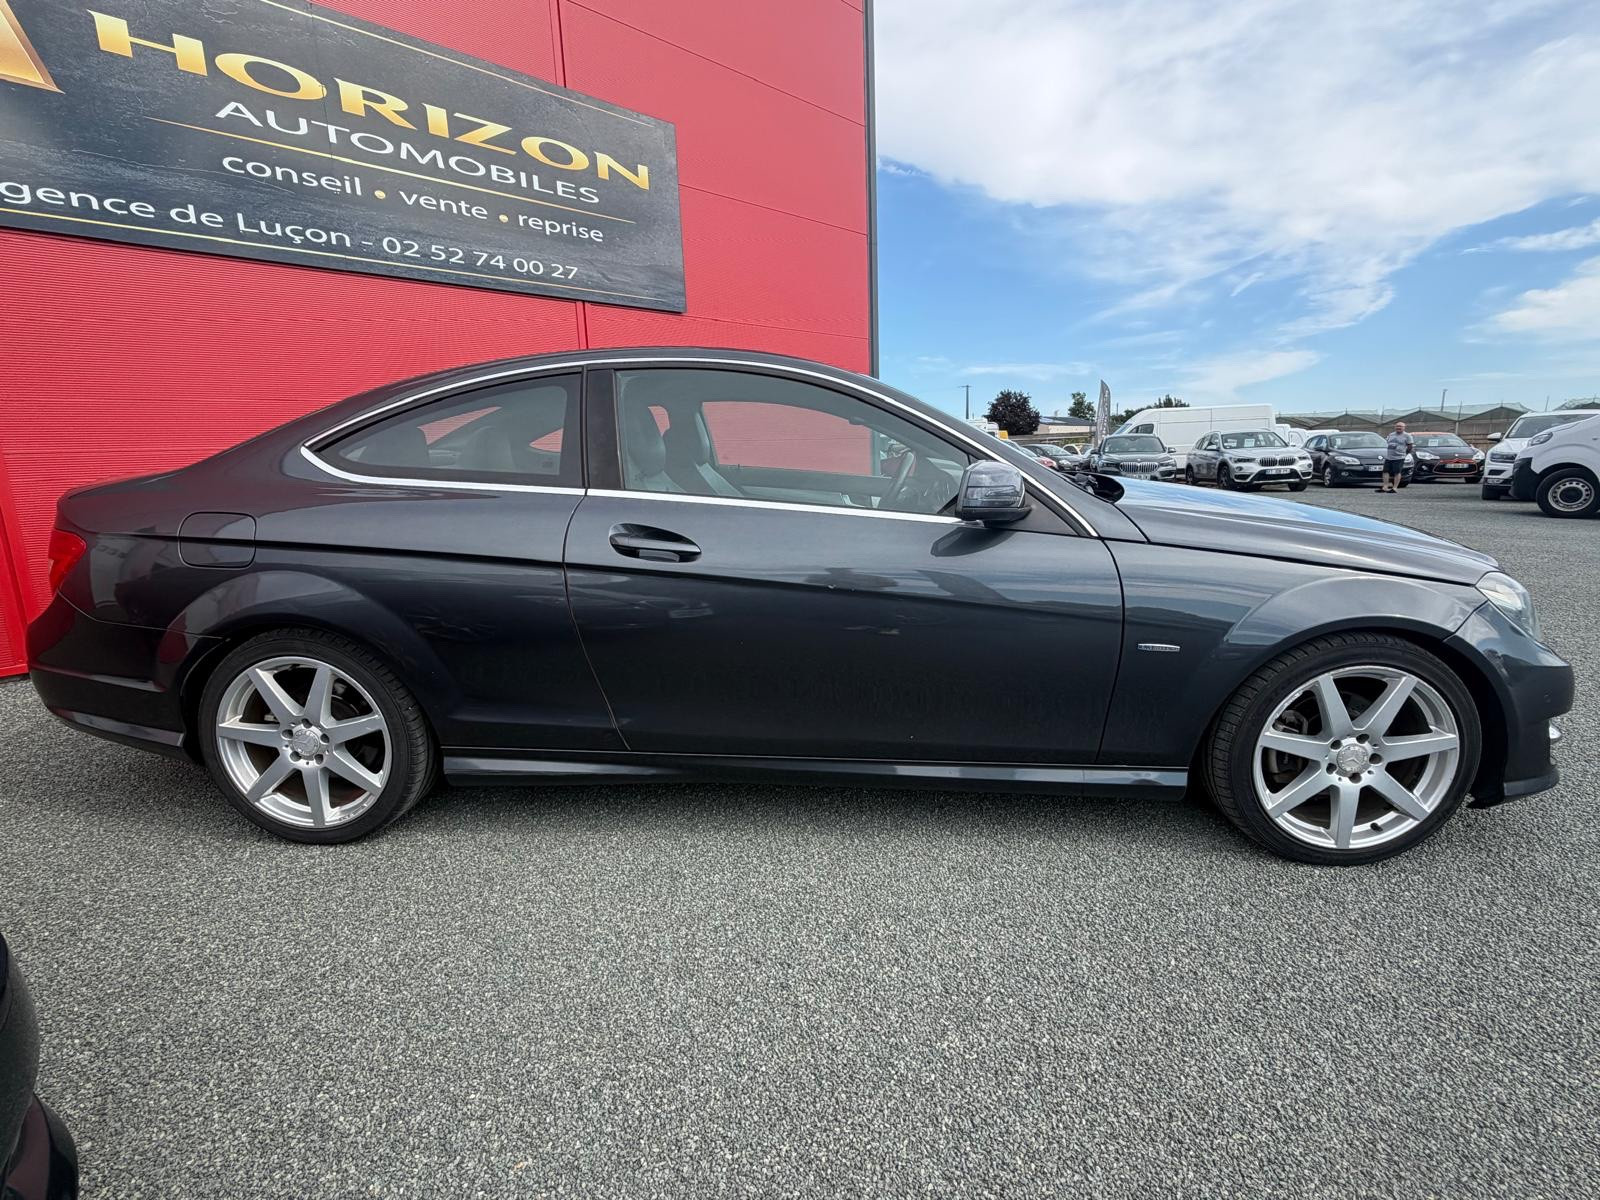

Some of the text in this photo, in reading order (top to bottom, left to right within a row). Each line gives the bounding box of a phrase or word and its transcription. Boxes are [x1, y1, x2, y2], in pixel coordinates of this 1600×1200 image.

[87, 9, 650, 191] HORIZON
[215, 101, 600, 204] AUTOMOBILES
[222, 156, 604, 243] conseil vente reprise
[169, 204, 224, 229] de
[236, 212, 352, 247] Luçon
[382, 236, 421, 258] 02
[430, 244, 465, 265] 52
[472, 251, 507, 270] 74
[513, 258, 544, 275] 00
[551, 263, 579, 280] 27
